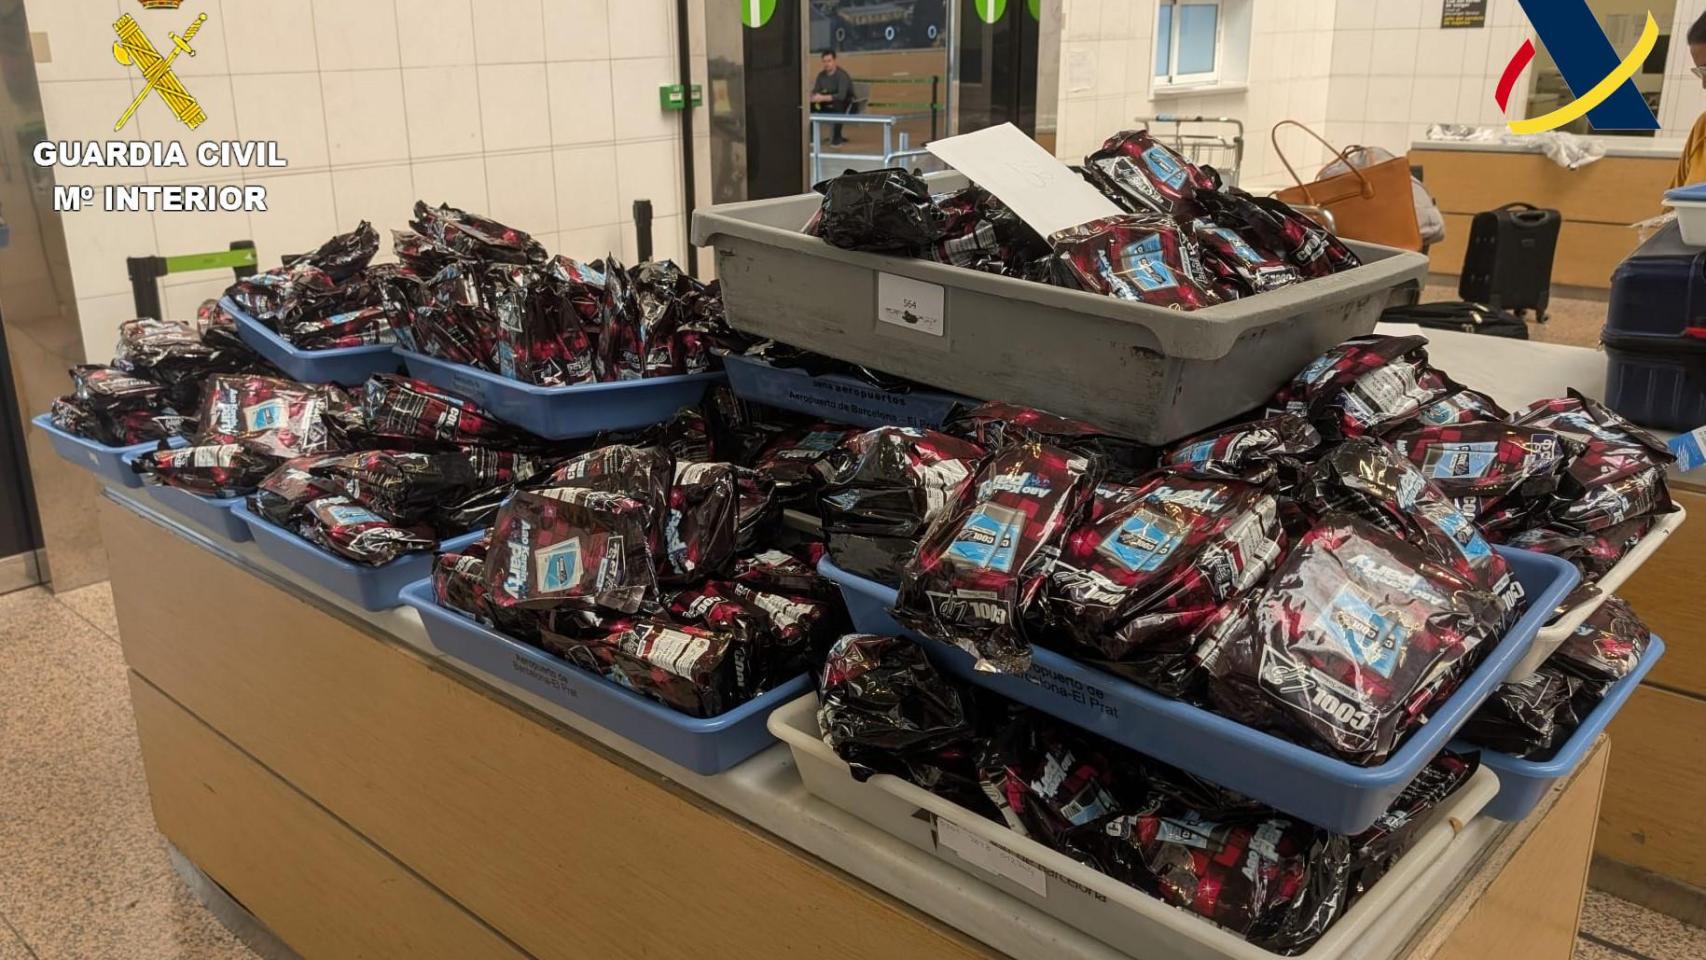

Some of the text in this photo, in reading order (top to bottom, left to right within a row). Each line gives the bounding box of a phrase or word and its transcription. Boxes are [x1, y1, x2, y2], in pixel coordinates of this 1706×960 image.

[903, 298, 917, 309] 564
[834, 383, 906, 406] aeropuertos
[788, 391, 837, 409] Aeropuerto
[838, 402, 850, 411] de
[851, 404, 898, 422] Barcelona
[970, 602, 1007, 624] COOL
[1090, 697, 1120, 720] Prat
[1312, 689, 1371, 731] COOL
